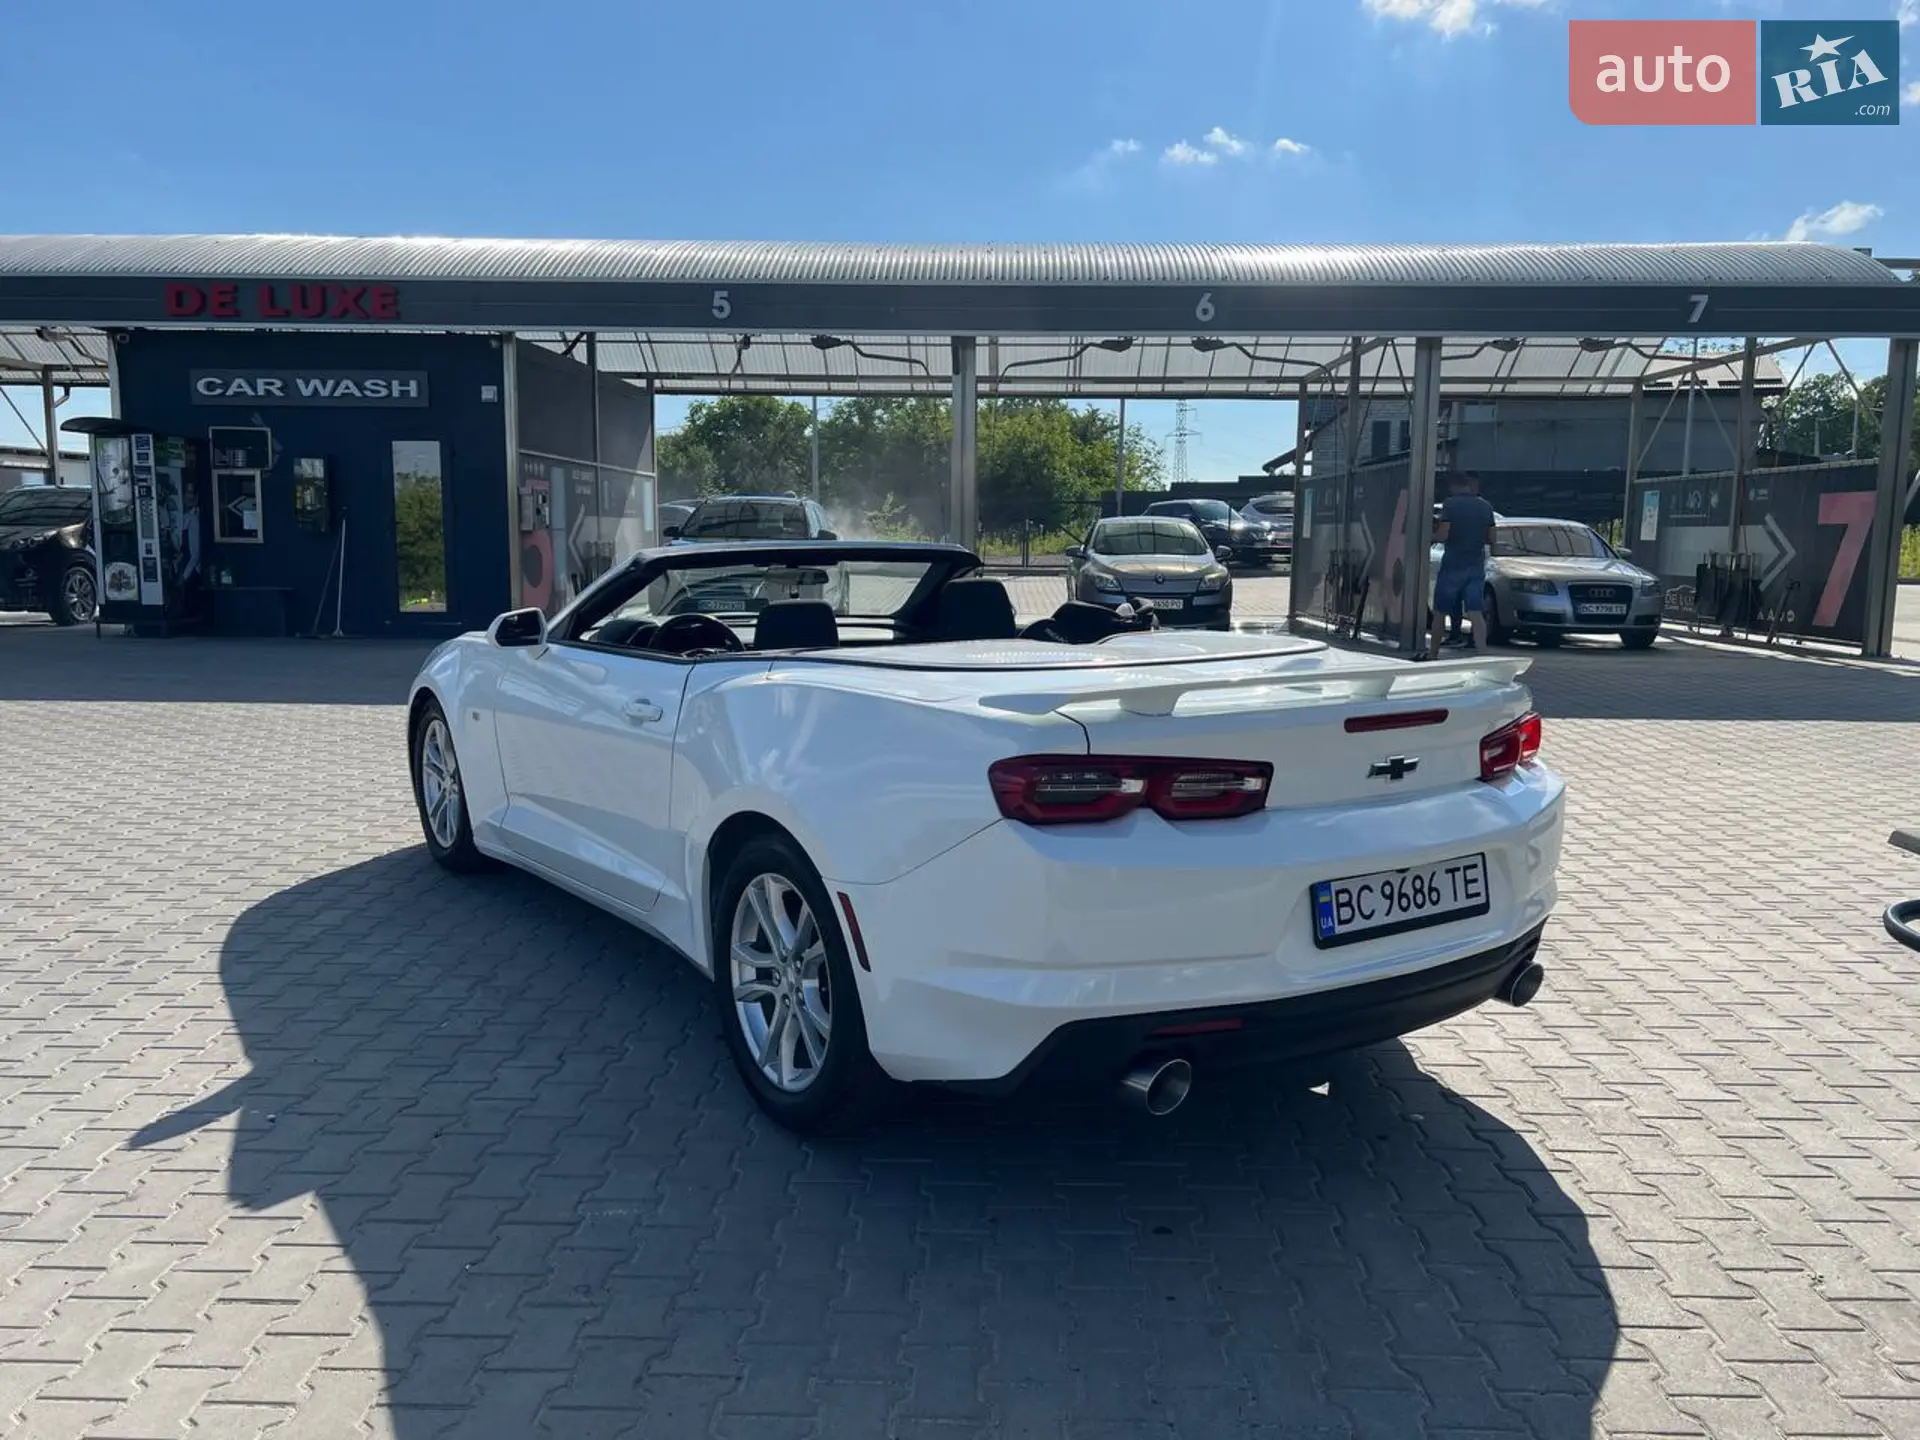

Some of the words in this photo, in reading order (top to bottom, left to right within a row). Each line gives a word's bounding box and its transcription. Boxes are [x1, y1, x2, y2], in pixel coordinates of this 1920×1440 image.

[164, 283, 240, 318] DE
[258, 283, 399, 319] LUXE
[712, 290, 731, 319] 5
[1196, 292, 1215, 321] 6
[1688, 294, 1709, 323] 7
[196, 377, 285, 397] CAR
[296, 378, 419, 398] WASH
[1812, 490, 1878, 627] 7
[1335, 885, 1375, 926] BC
[1380, 871, 1441, 917] 9686
[1445, 864, 1481, 902] TE
[1320, 917, 1333, 929] UA
